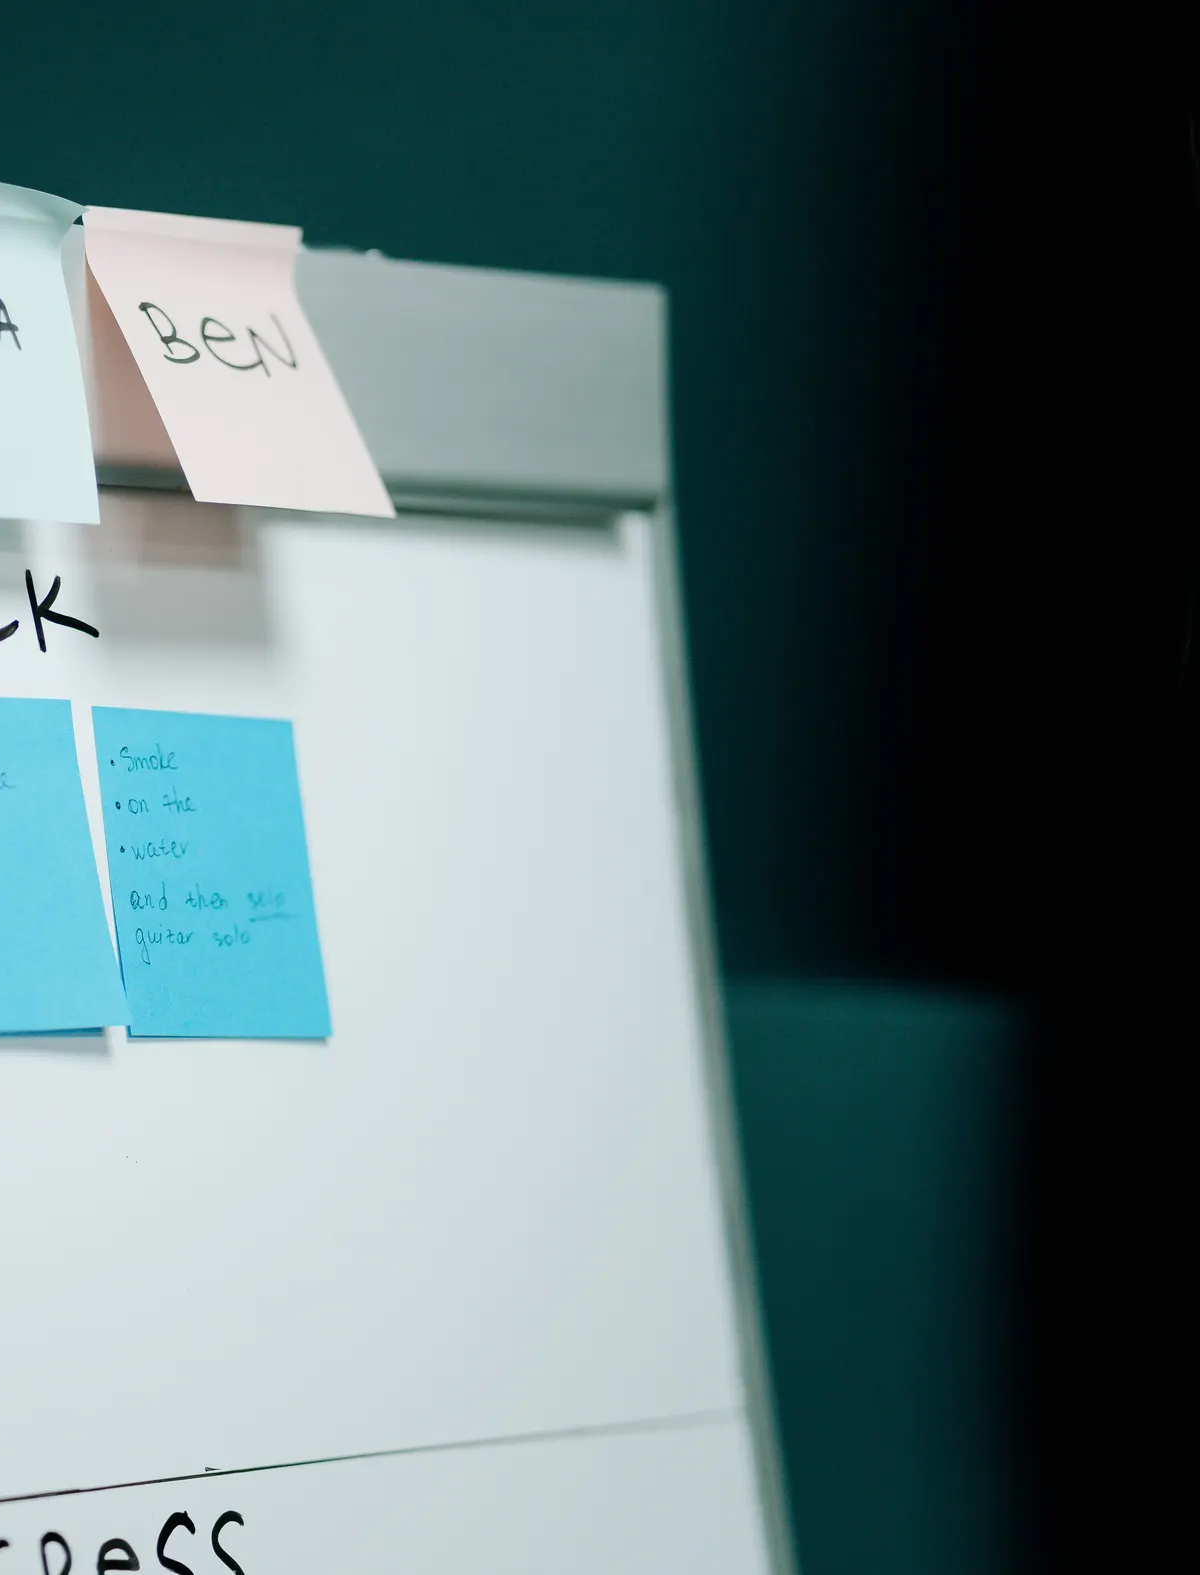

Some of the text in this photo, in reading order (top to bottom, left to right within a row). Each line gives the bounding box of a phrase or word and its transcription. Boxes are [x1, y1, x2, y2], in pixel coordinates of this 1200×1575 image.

[127, 785, 198, 815] on the
[130, 838, 190, 861] water
[130, 881, 169, 912] and
[135, 923, 251, 966] guitar solo
